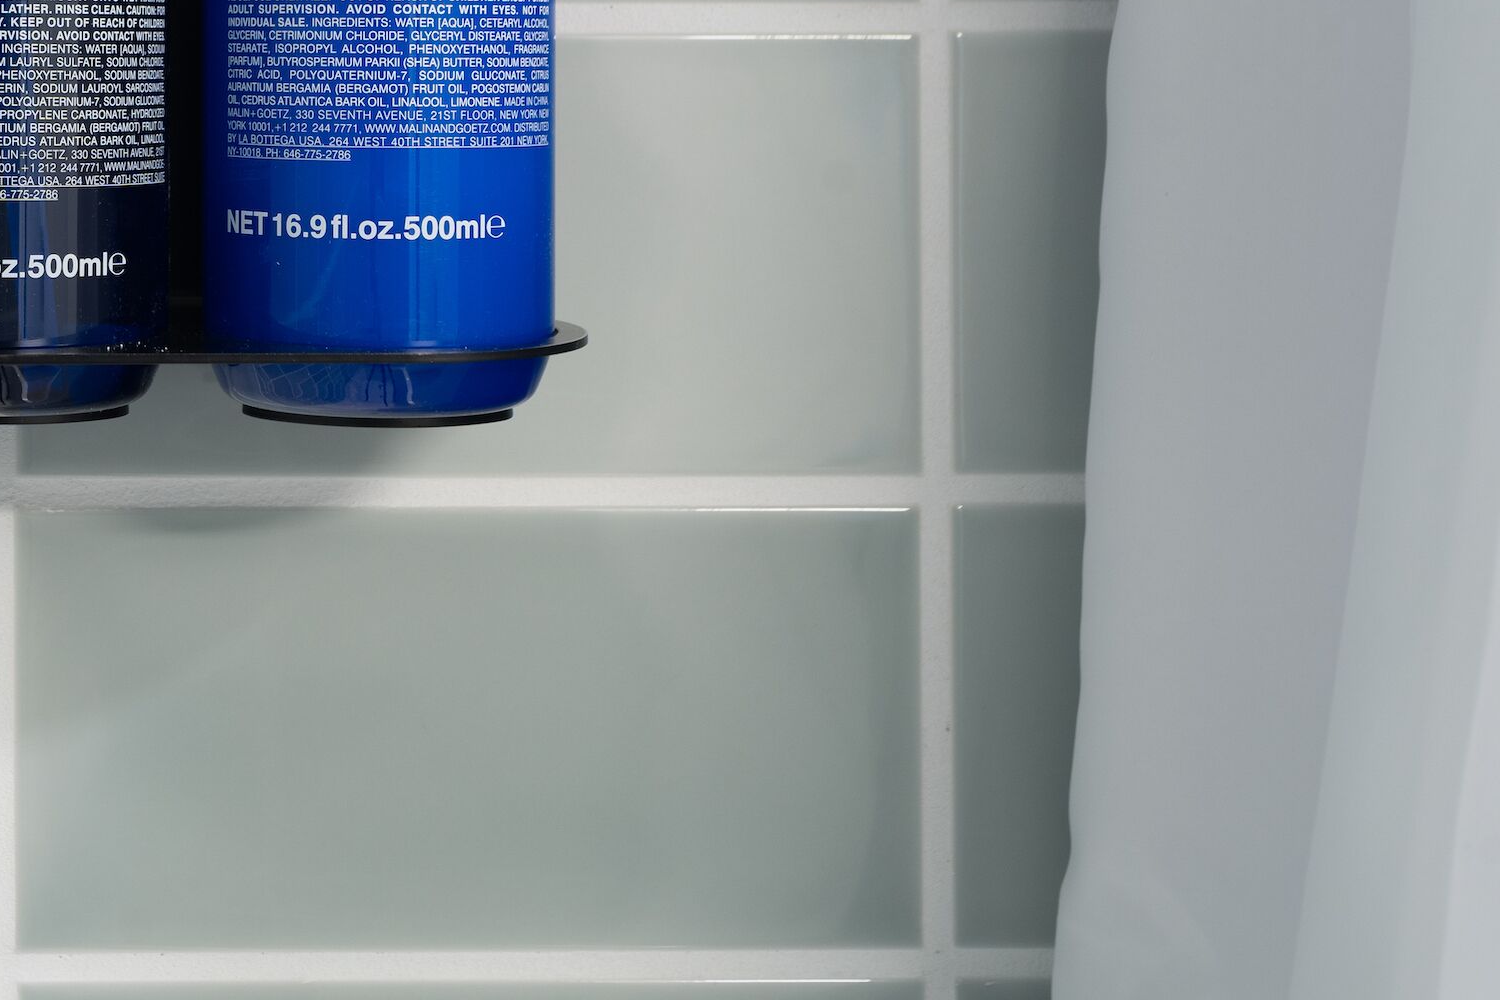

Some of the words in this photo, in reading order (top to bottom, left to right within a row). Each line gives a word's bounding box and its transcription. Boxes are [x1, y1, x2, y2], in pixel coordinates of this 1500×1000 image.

[227, 4, 254, 14] ADULT
[258, 4, 339, 14] SUPERVISION.
[346, 4, 386, 15] AVOID
[392, 4, 453, 15] CONTACT
[458, 4, 487, 15] WITH
[492, 5, 518, 15] EYES.
[10, 17, 44, 28] KEEP
[46, 17, 72, 28] OUT
[74, 17, 90, 28] OF
[92, 17, 125, 28] REACH
[126, 18, 138, 28] OF
[32, 83, 78, 94] SODIUM
[81, 83, 124, 94] LAUROYL
[227, 107, 292, 121] MALIN+GOETZ,
[295, 109, 314, 120] 330
[317, 110, 371, 121] SEVENTH
[375, 110, 426, 122] AVENUE,
[430, 110, 457, 121] 21ST
[460, 110, 496, 122] FLOOR,
[499, 109, 519, 120] NEW
[265, 147, 280, 158] PH:
[283, 148, 351, 160] 646-775-2786
[227, 209, 268, 236] NET
[272, 212, 327, 239] 16.9
